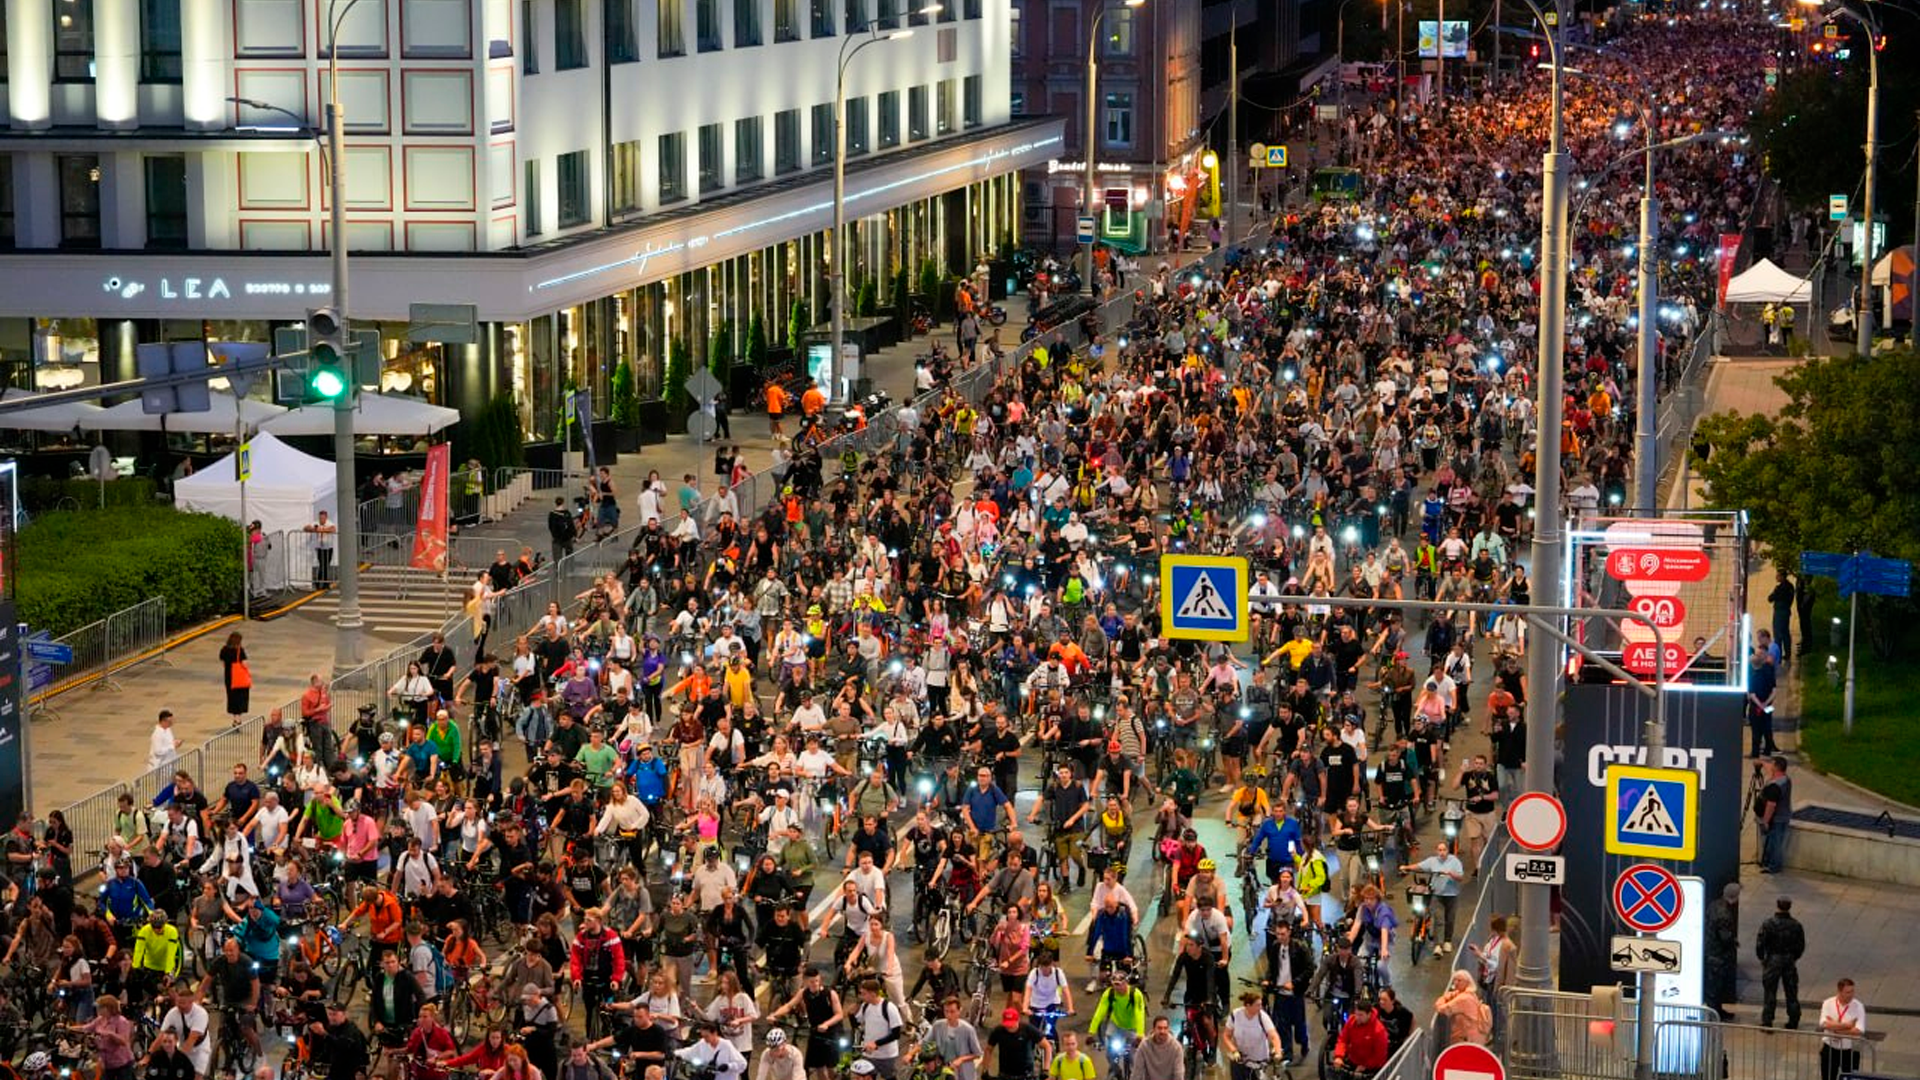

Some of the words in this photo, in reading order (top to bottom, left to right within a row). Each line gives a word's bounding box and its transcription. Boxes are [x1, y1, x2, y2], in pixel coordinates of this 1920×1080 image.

[160, 278, 231, 298] LEA
[1632, 648, 1678, 660] ЛЕО
[1531, 861, 1546, 872] 2,5
